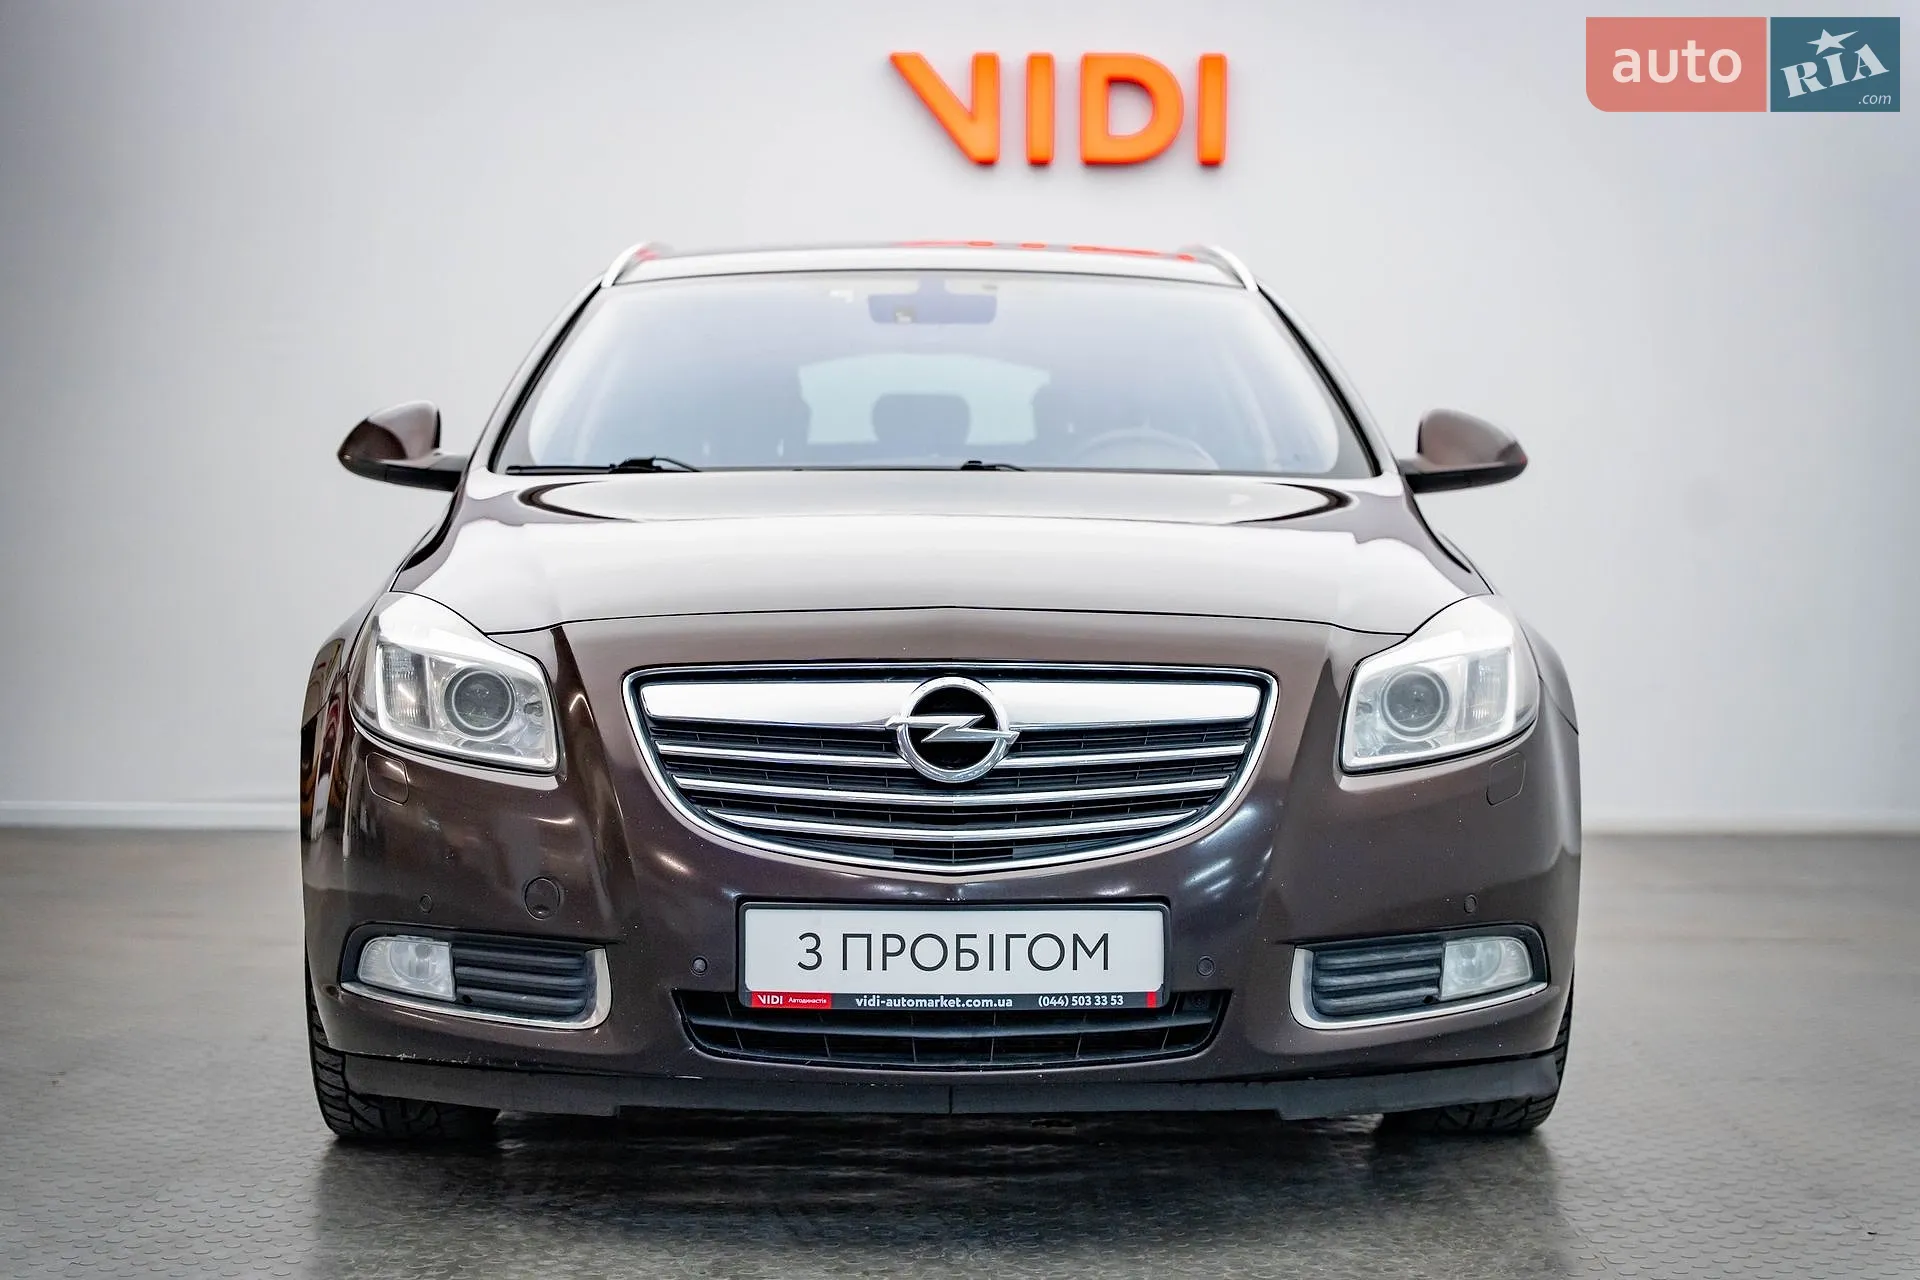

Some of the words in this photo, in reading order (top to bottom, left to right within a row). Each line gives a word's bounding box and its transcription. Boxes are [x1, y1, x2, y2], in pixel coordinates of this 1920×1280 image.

[889, 52, 1229, 166] VIDI
[842, 932, 1109, 972] ПРОБІГОМ
[757, 994, 783, 1005] VIDI
[855, 994, 1013, 1008] vidi-automarket.com.ua
[1038, 994, 1069, 1008] (044)
[1071, 995, 1092, 1006] 503
[1094, 995, 1108, 1006] 33
[1110, 995, 1124, 1006] 53
